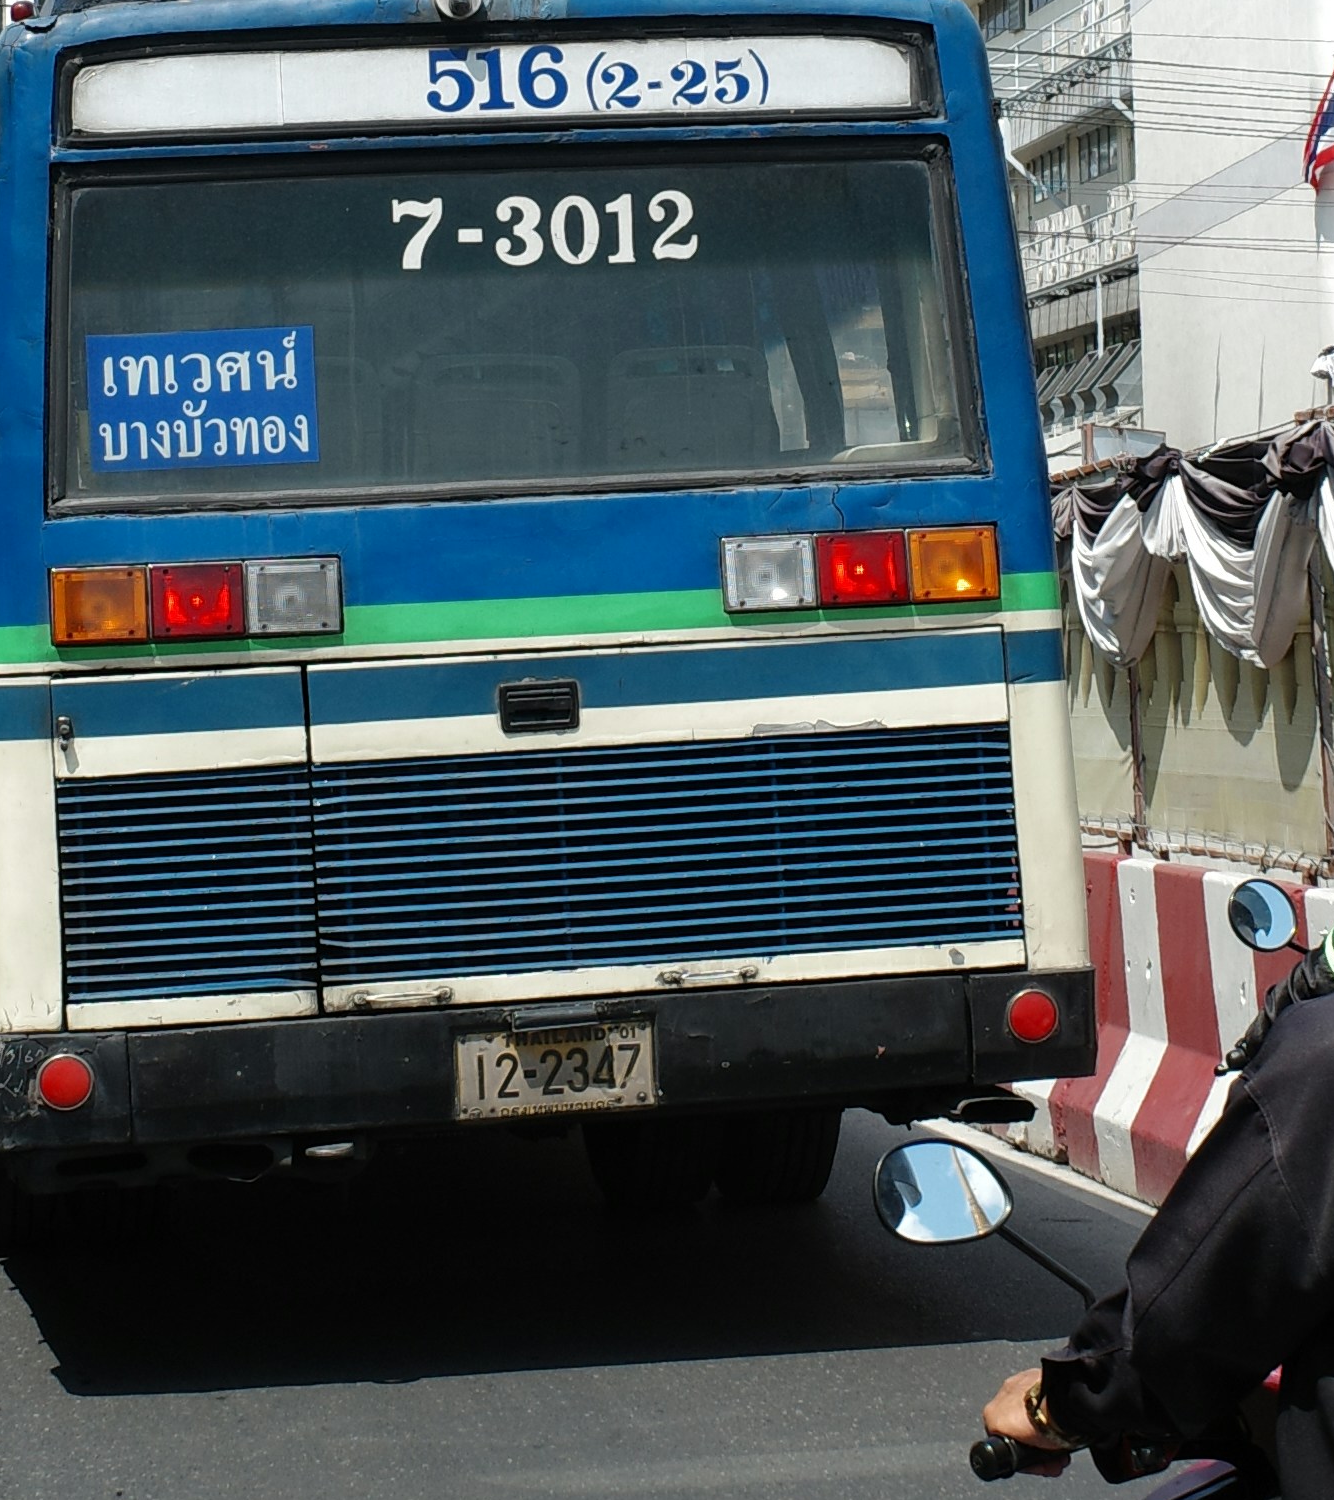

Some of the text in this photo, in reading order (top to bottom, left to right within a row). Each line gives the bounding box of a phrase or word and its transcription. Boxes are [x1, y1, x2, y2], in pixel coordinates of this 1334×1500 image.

[427, 43, 770, 113] 516 (2-25)
[391, 188, 700, 271] 7-3012
[102, 330, 299, 398] เทเวศน์
[98, 399, 310, 462] บางบัวทอง
[475, 1043, 642, 1101] 12-2347
